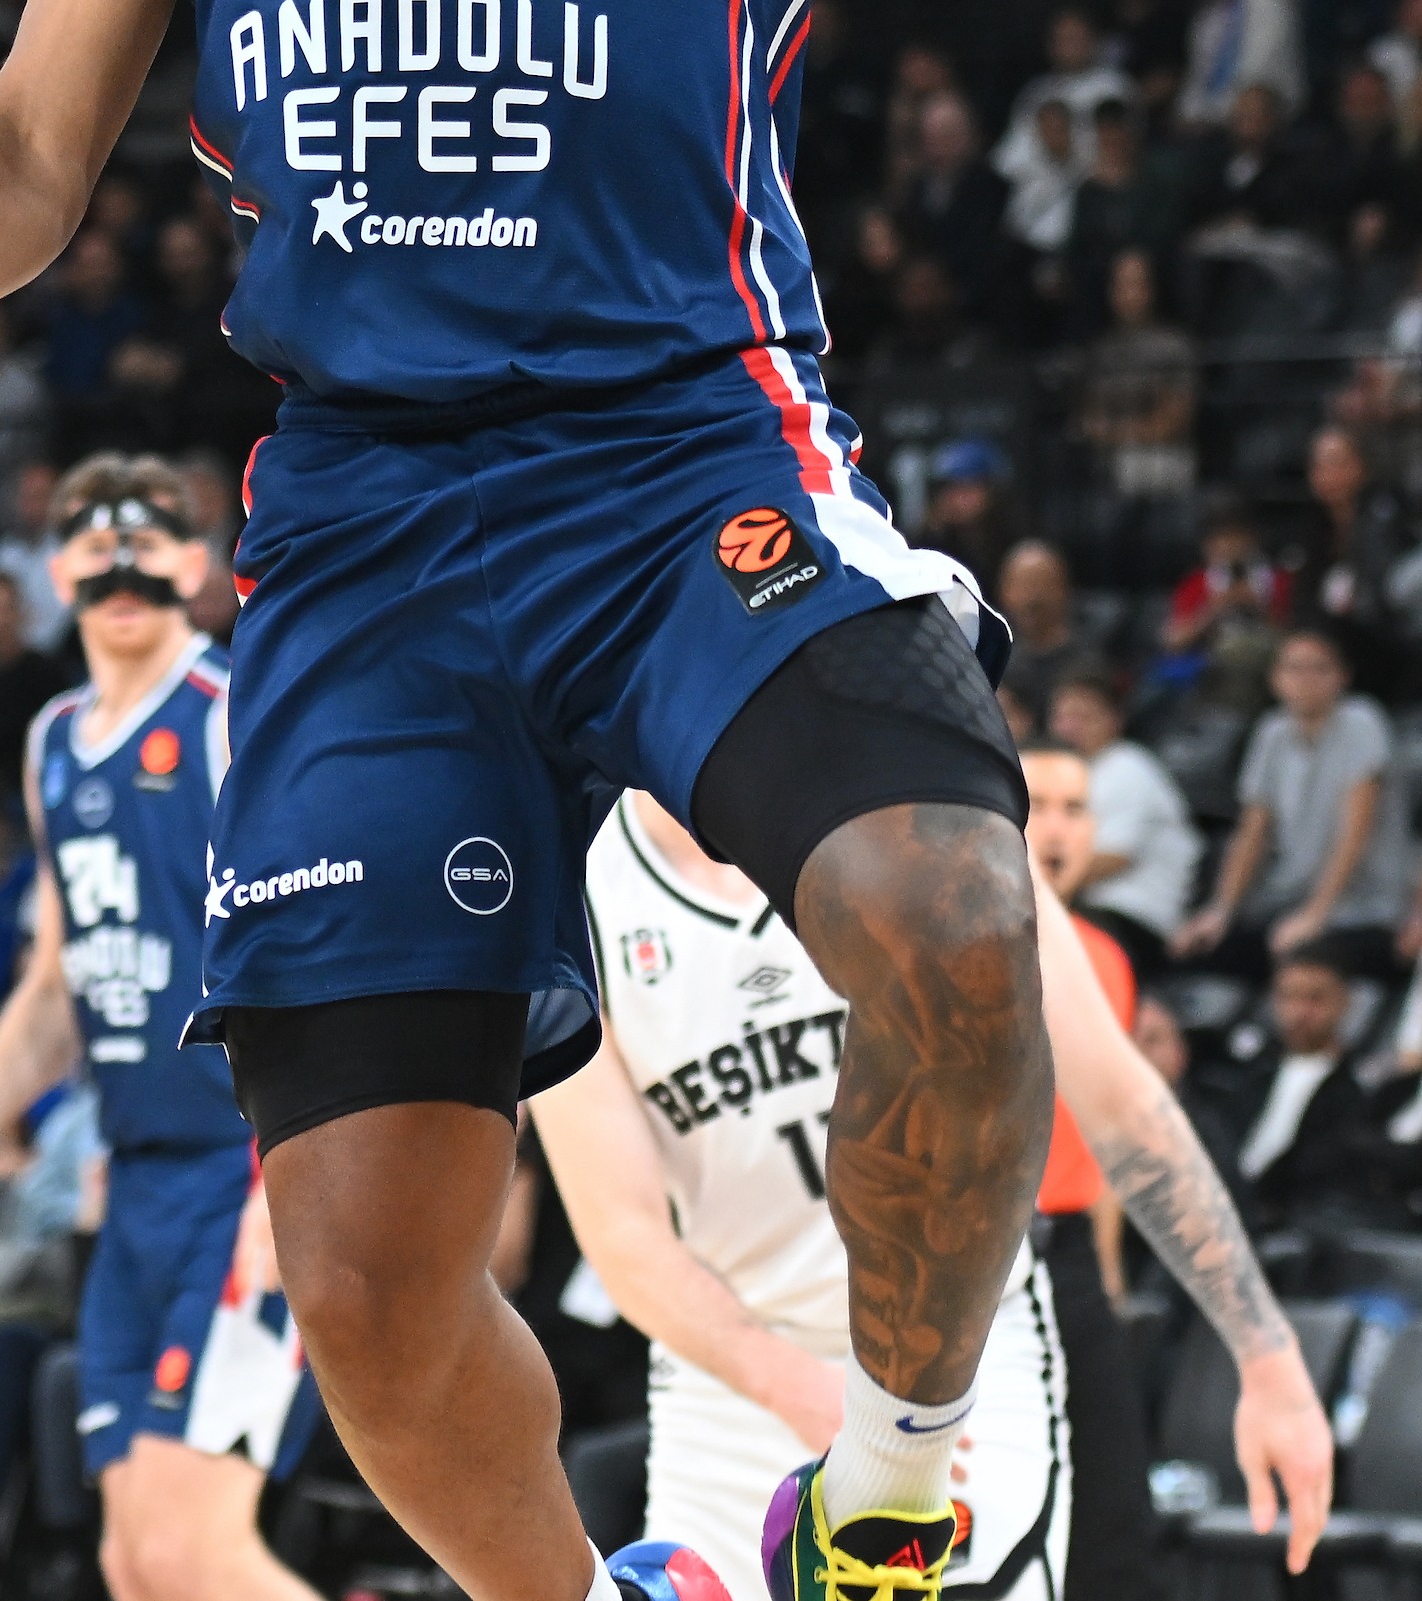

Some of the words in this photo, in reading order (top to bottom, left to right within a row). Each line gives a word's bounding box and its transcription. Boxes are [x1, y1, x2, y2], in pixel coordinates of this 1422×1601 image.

[283, 86, 551, 172] EFES
[360, 208, 537, 248] corendon
[749, 565, 818, 608] ETIHAD
[233, 858, 364, 908] corendon
[450, 867, 508, 882] GSA
